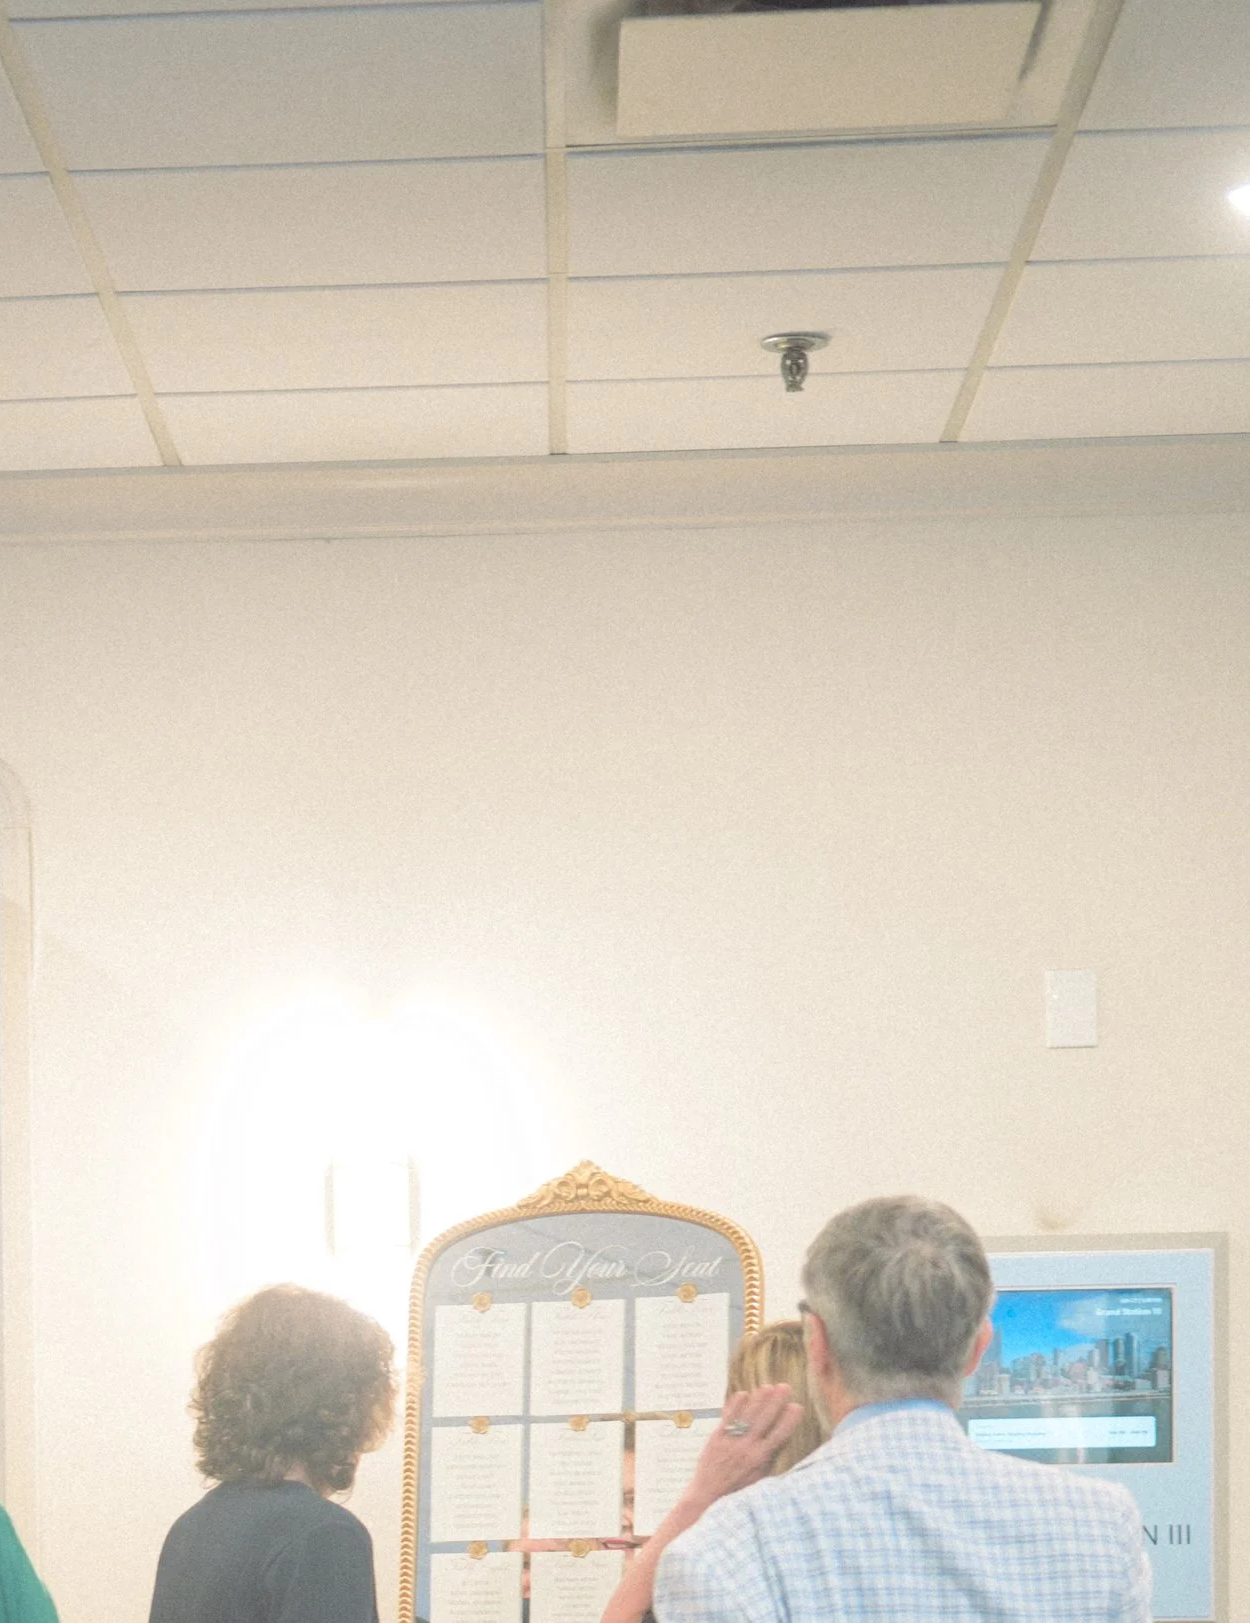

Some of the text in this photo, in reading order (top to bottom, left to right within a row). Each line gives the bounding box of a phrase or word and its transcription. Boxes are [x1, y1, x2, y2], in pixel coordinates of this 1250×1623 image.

[452, 1240, 723, 1296] Find Your Seat
